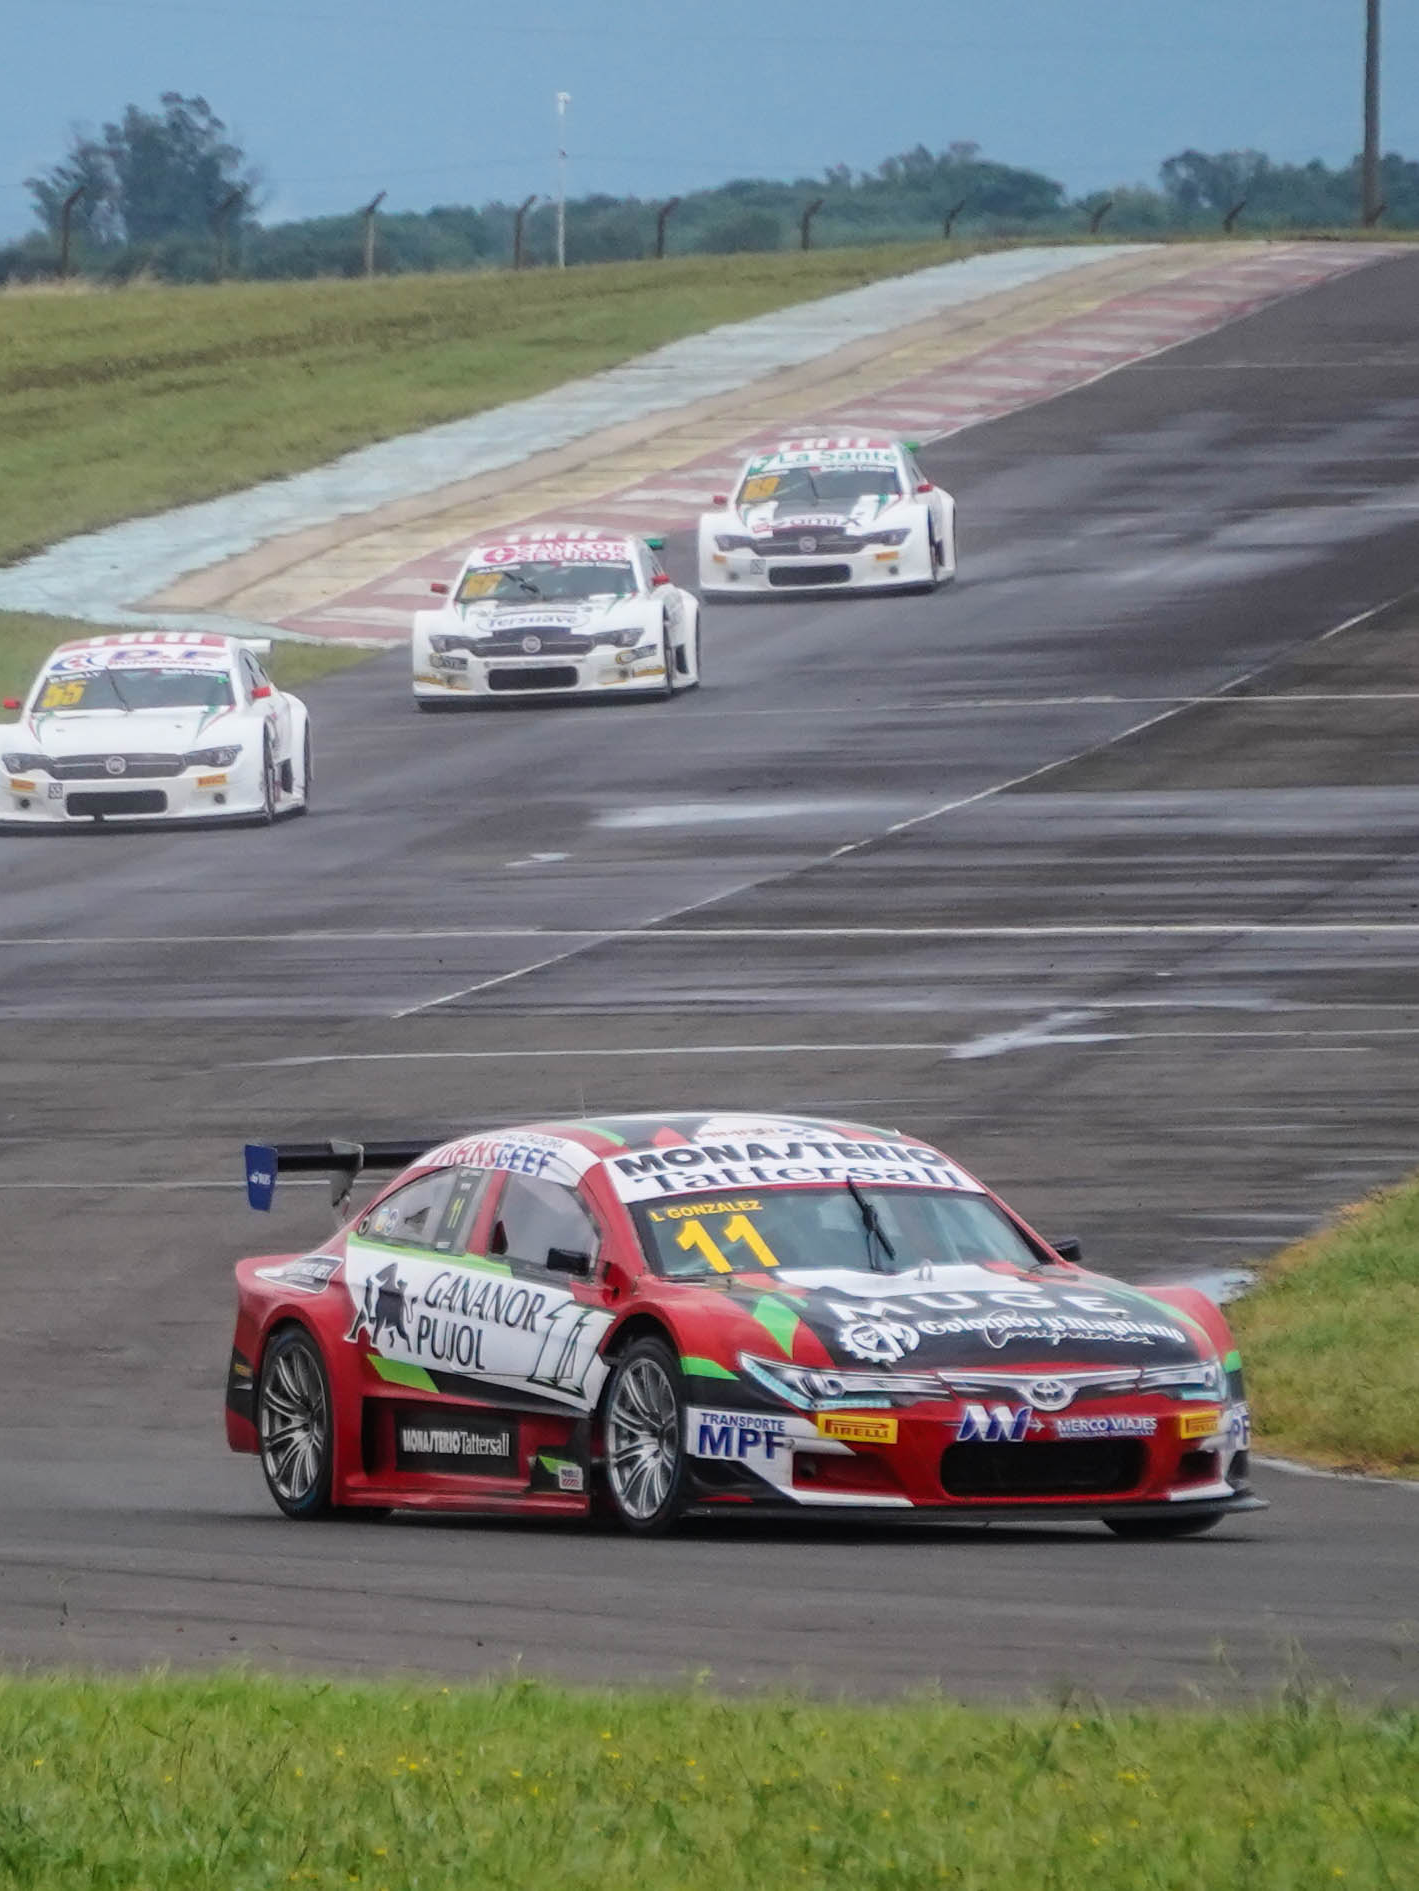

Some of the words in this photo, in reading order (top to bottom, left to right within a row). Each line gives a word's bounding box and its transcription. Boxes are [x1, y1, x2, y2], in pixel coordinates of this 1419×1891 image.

[614, 1140, 950, 1178] MONASTERIO
[634, 1162, 965, 1194] Tattersall
[667, 1200, 764, 1220] GONZALEZ
[675, 1214, 781, 1274] 11
[424, 1271, 547, 1333] GANANOR
[417, 1315, 486, 1371] PUJOL
[700, 1412, 786, 1432] TRANSPORTE
[825, 1417, 888, 1439] PIRELLI
[1057, 1419, 1109, 1433] MERCO
[1109, 1416, 1159, 1431] VIAJES
[460, 1431, 510, 1457] Tattersall
[698, 1424, 786, 1460] MPF
